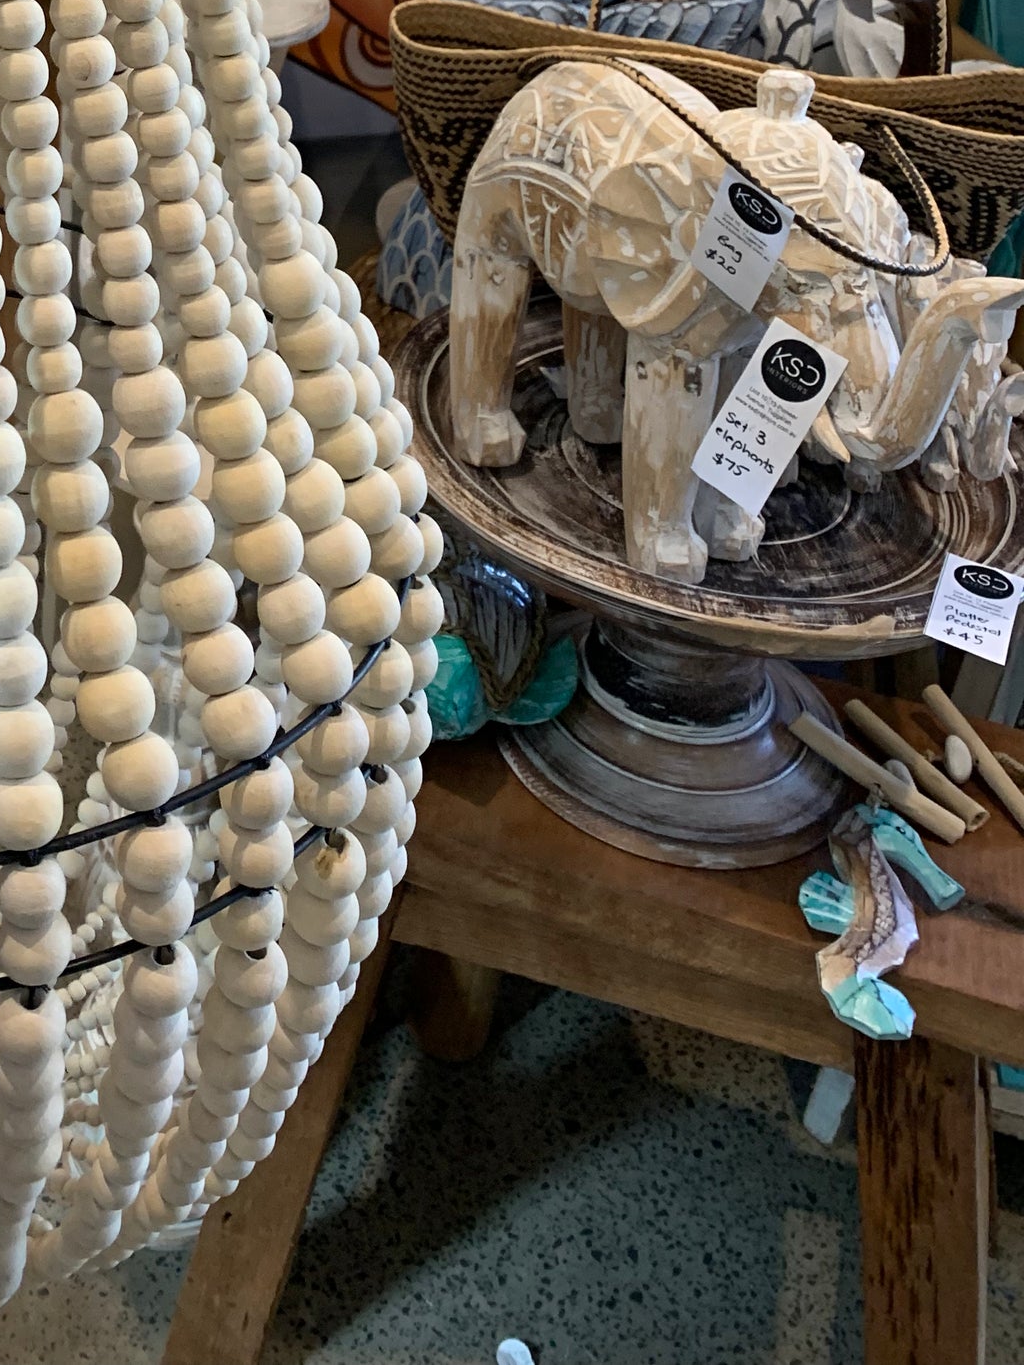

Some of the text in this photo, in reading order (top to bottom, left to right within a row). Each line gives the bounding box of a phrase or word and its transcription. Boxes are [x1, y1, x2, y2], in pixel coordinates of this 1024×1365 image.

[704, 248, 736, 275] $20
[717, 234, 742, 263] Bag
[766, 364, 808, 394] INTERIORS
[726, 411, 766, 445] Set 3
[712, 453, 750, 476] $75
[715, 427, 775, 474] elephants
